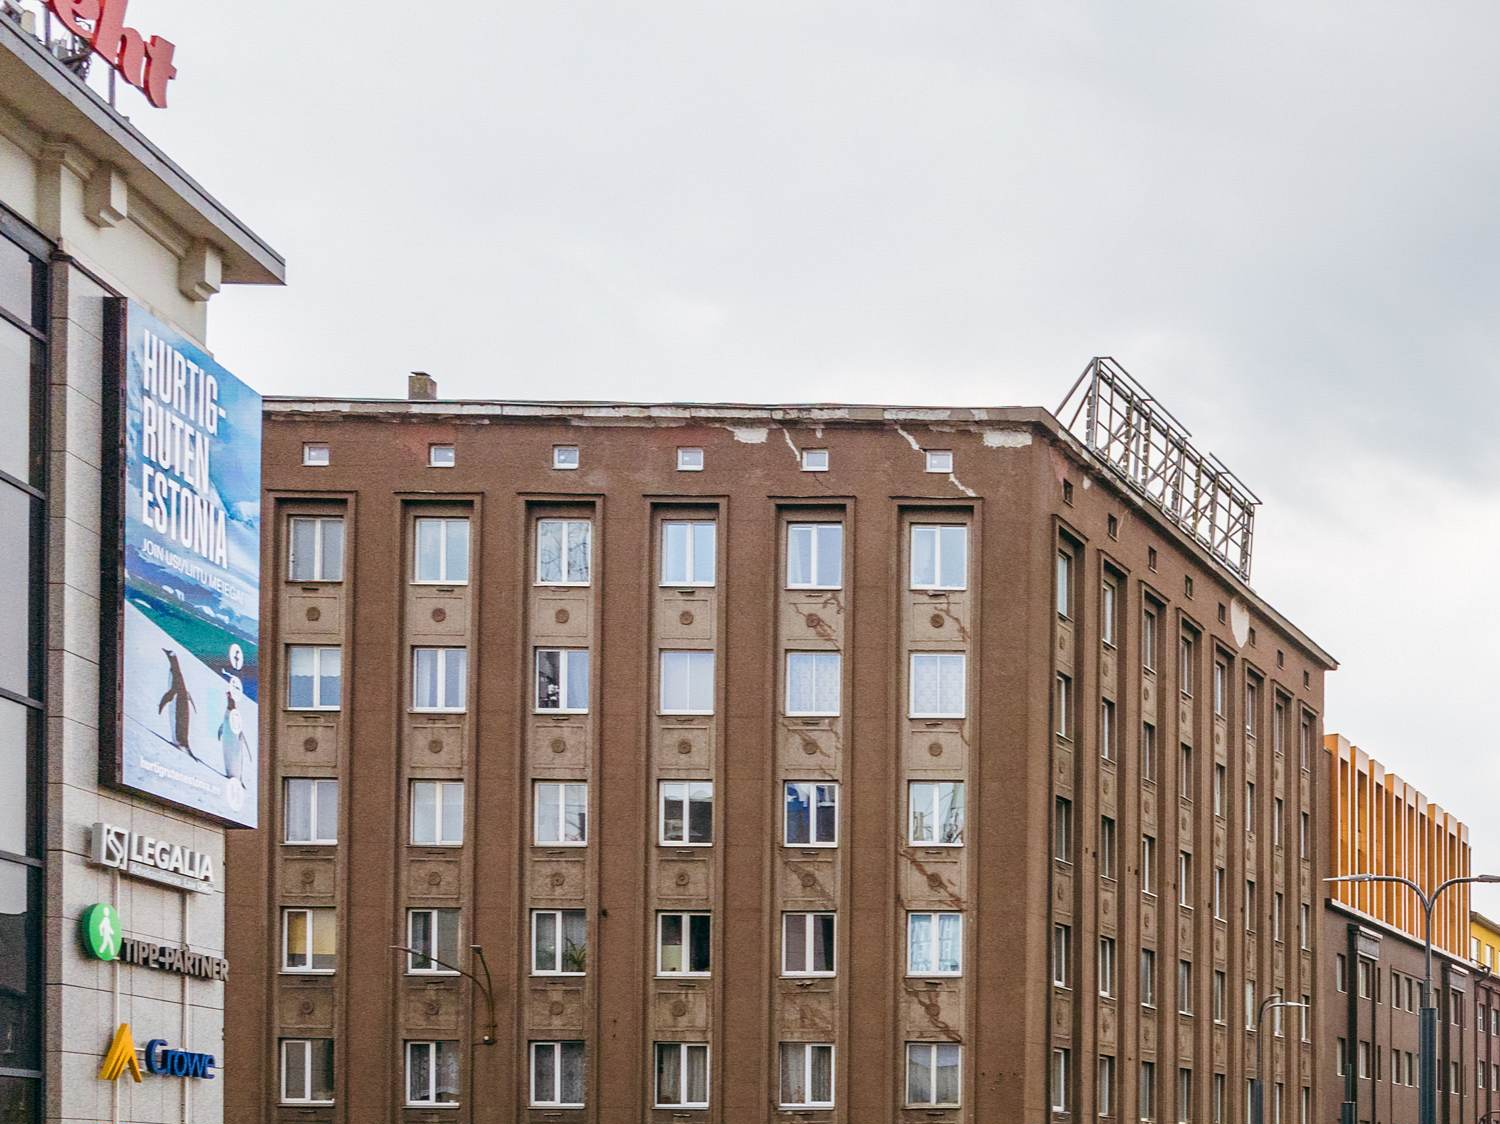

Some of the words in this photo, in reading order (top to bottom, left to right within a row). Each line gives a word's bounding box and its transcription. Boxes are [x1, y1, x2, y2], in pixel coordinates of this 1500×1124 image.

[143, 329, 227, 437] HURTIG-
[143, 395, 210, 494] RUTEN
[141, 463, 228, 569] ESTONIA
[130, 832, 214, 883] LEGALIA
[122, 937, 230, 982] TIPP-PARTNER
[145, 1038, 216, 1080] Crowe
